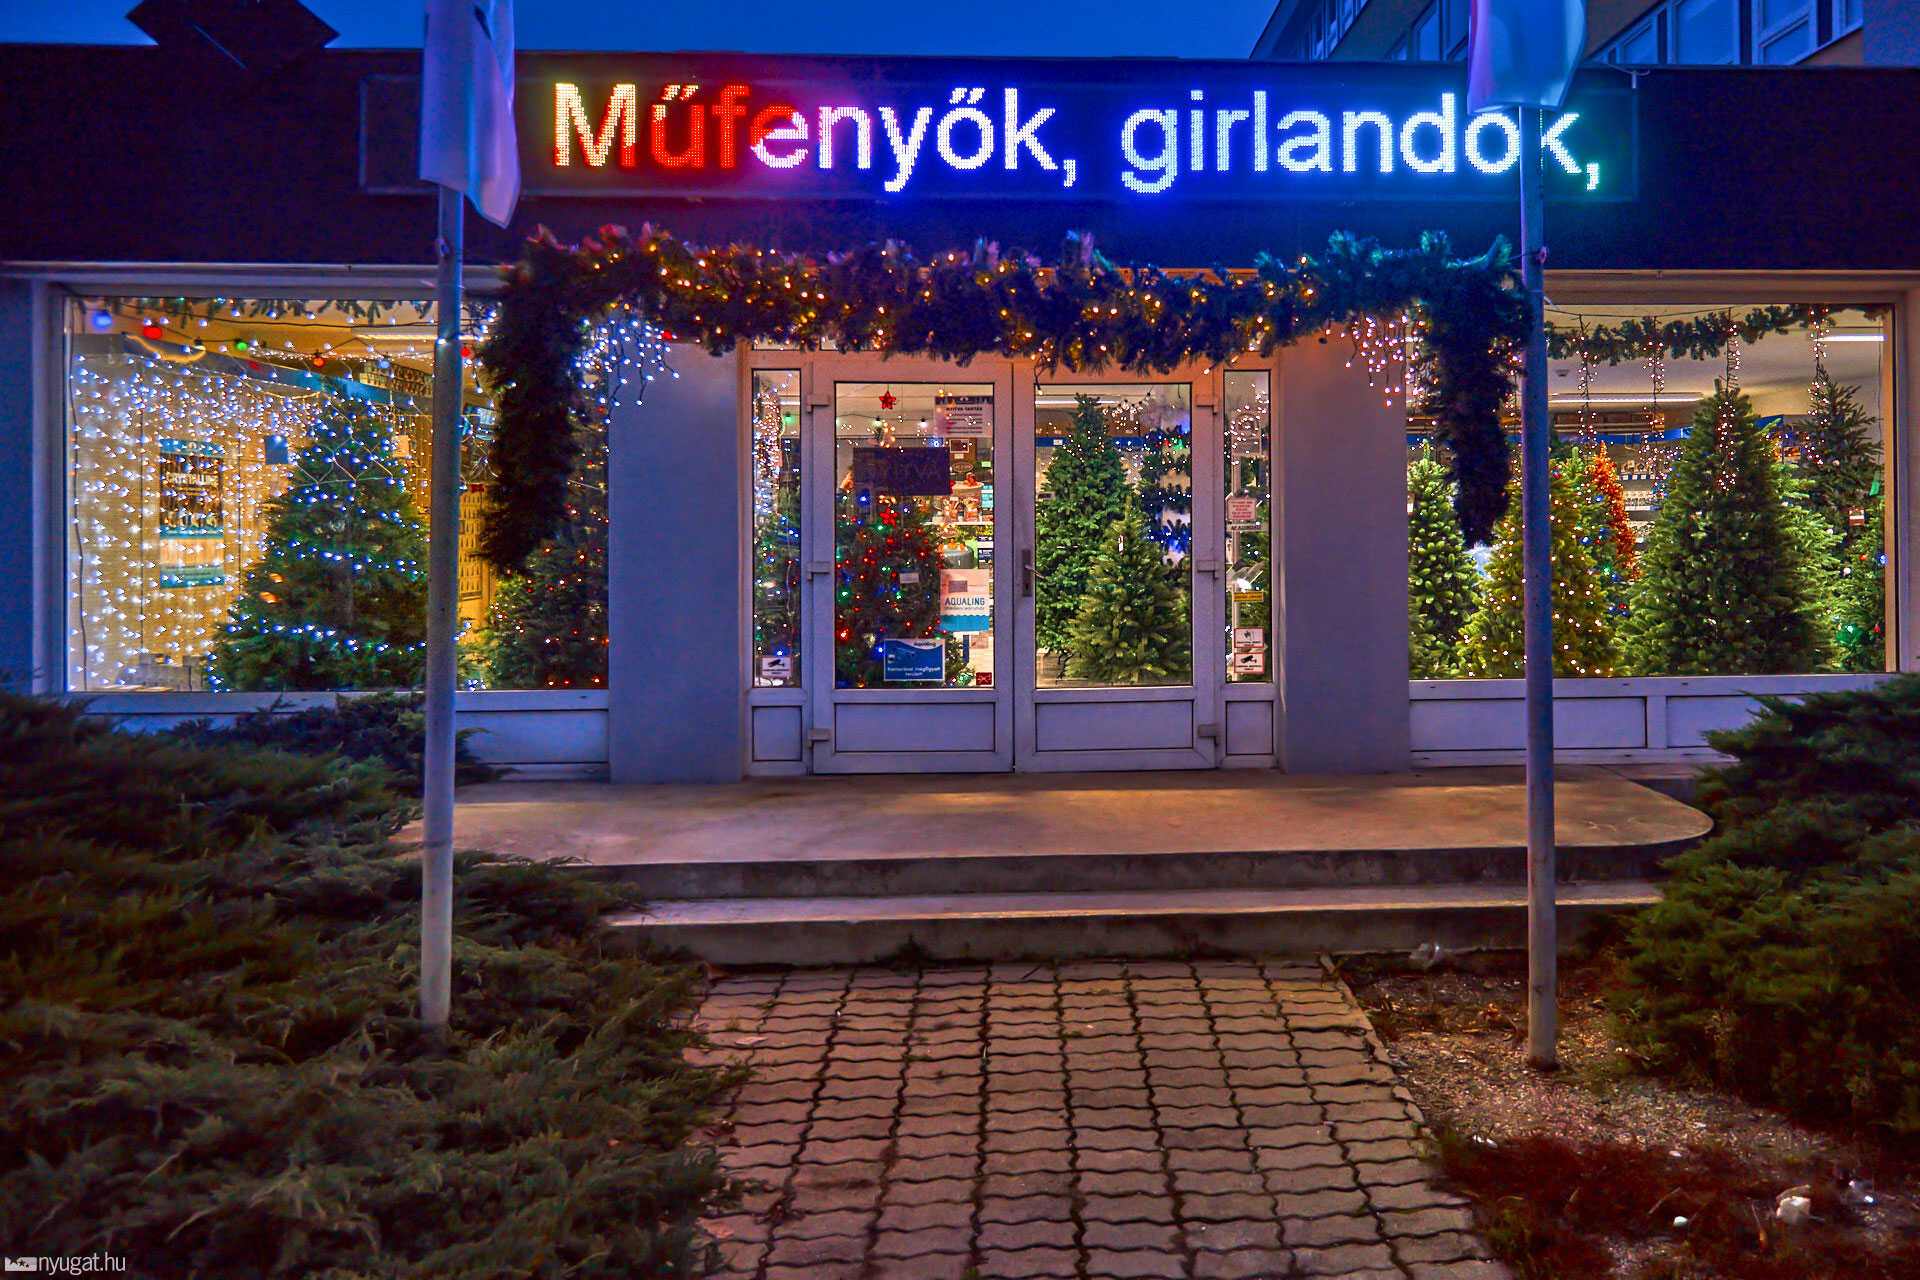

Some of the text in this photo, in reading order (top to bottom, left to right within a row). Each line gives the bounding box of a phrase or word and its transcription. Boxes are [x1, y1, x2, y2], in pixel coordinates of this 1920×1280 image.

[554, 82, 1600, 194] Műfenyők, girlandok,
[945, 597, 985, 606] AQUALING
